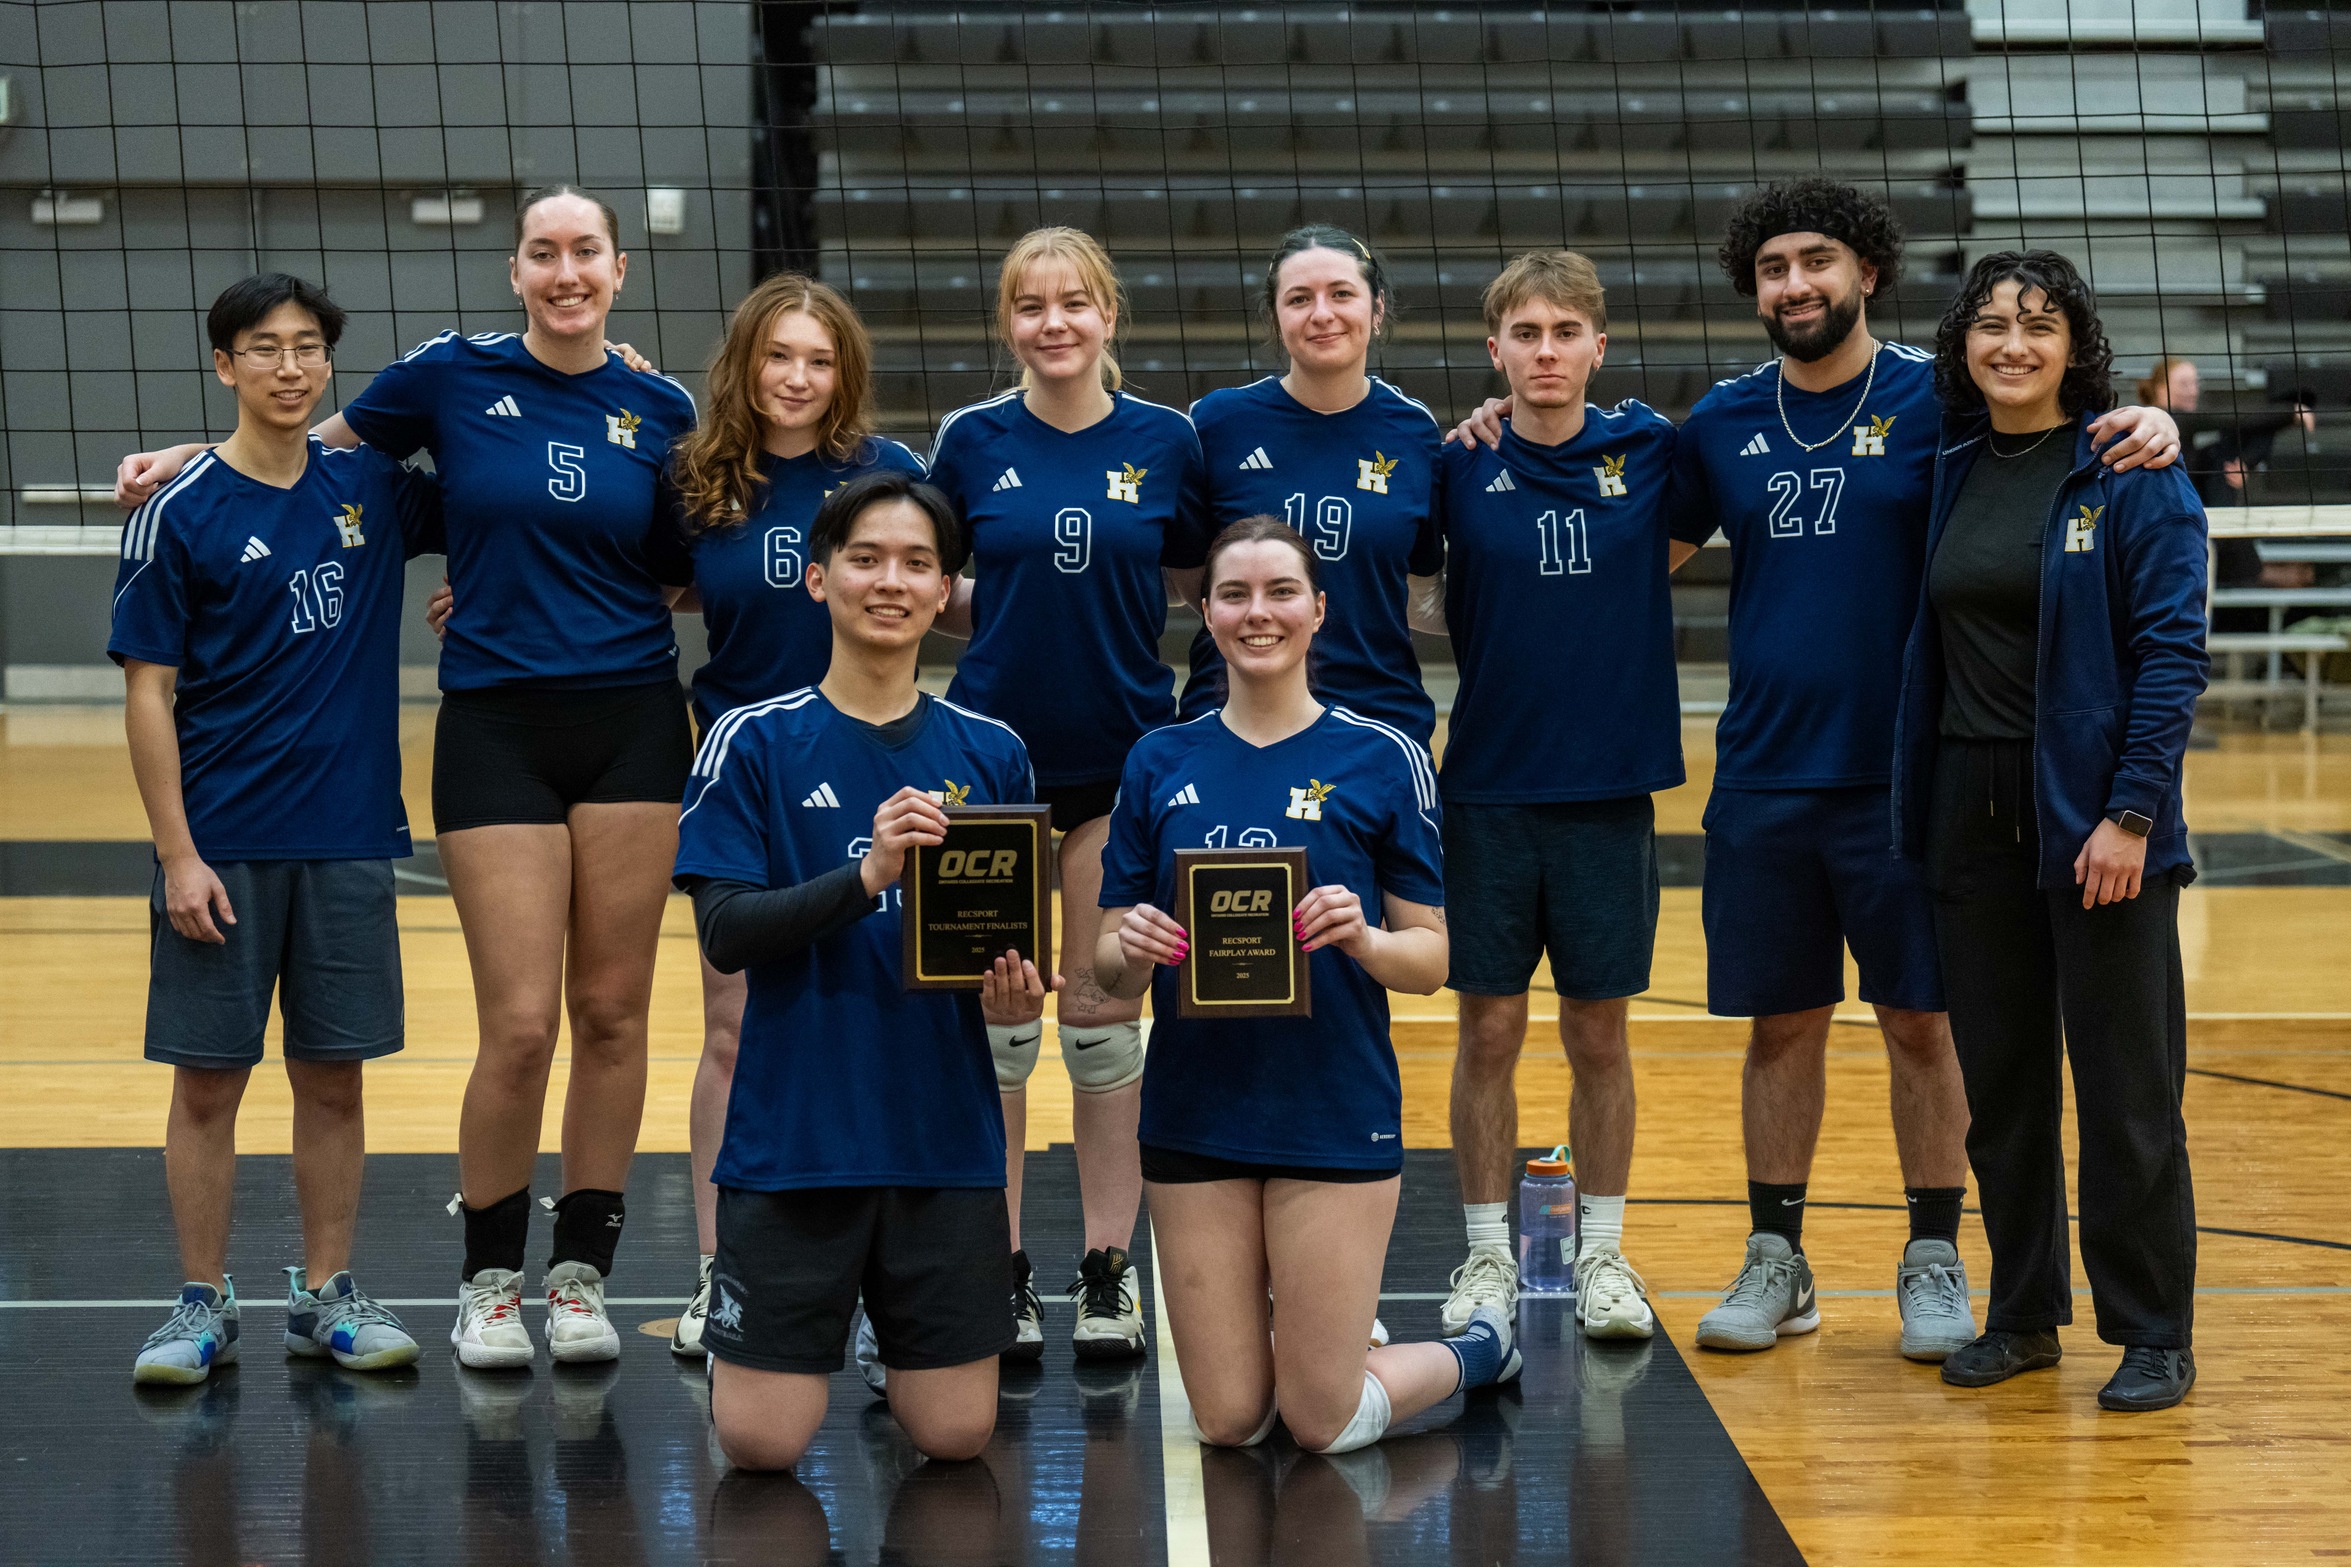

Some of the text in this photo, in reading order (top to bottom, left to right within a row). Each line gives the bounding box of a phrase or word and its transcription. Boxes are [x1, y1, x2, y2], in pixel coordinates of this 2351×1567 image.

[548, 441, 585, 502] 5
[1284, 493, 1352, 561] 19
[1767, 467, 1845, 538] 27
[764, 526, 802, 588] 6
[1054, 507, 1091, 573] 9
[1537, 508, 1592, 575] 11
[289, 560, 344, 633] 16
[938, 850, 1018, 878] OCR
[928, 921, 1028, 931] TOURNAMENT FINALISTS
[957, 910, 998, 918] RECSPORT
[1210, 889, 1272, 912] OCR
[1222, 937, 1262, 945] RECSPORT
